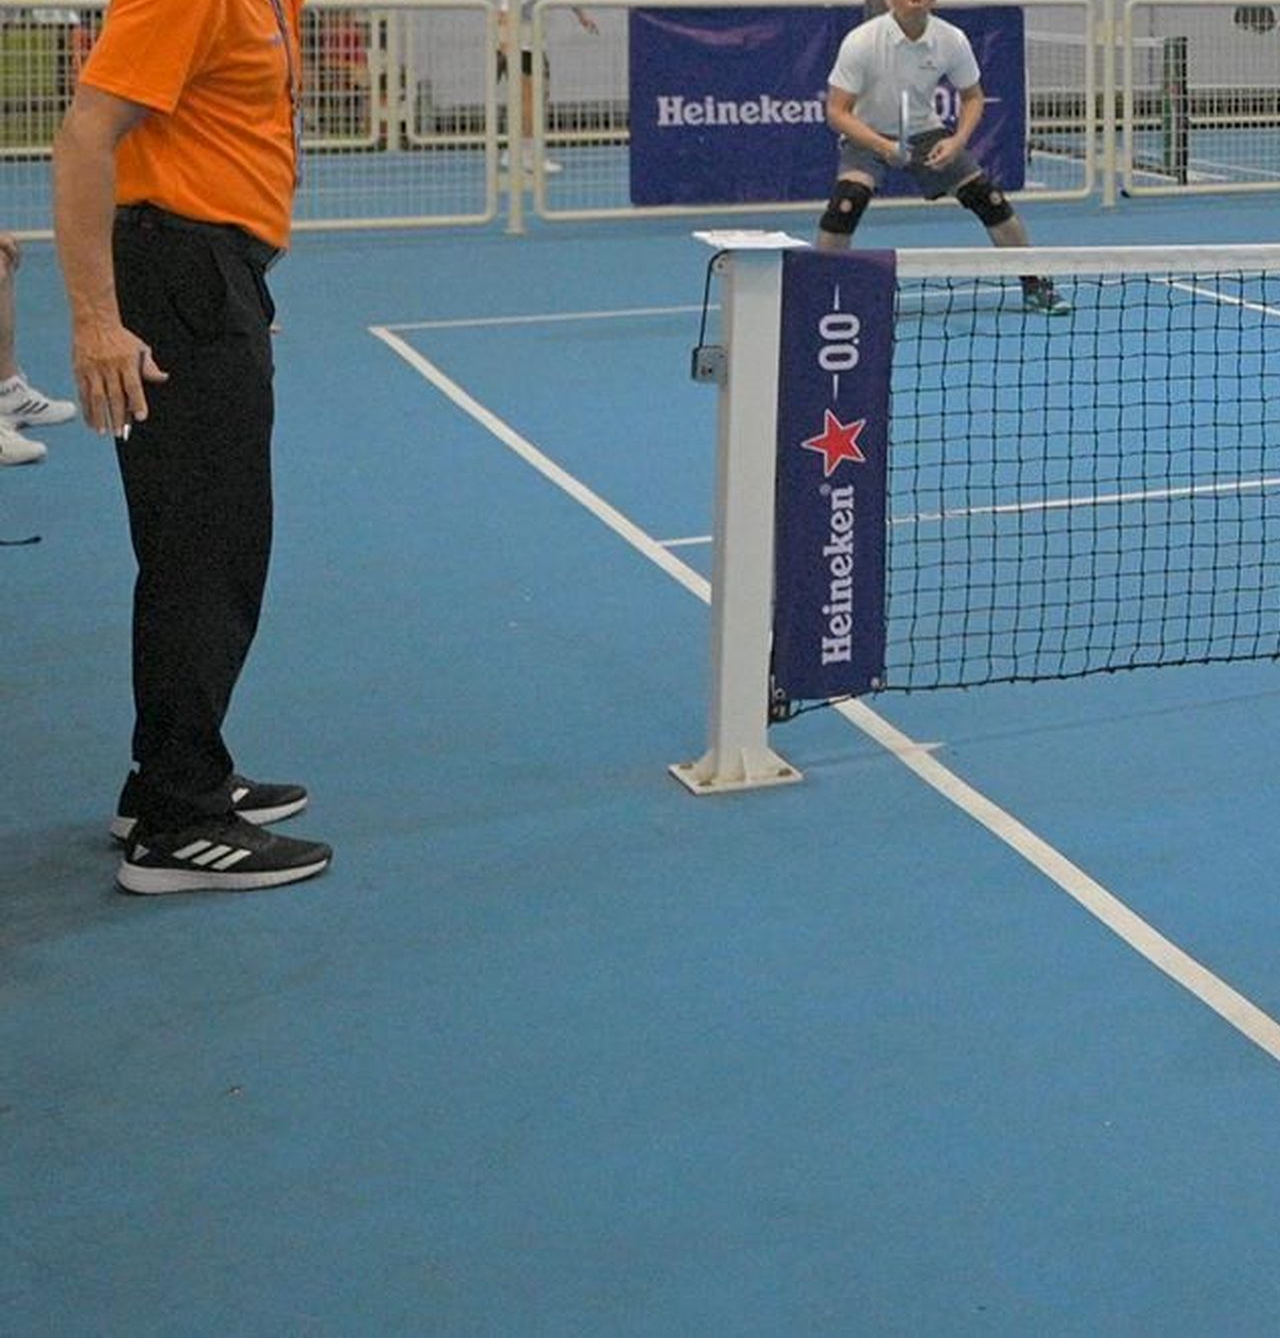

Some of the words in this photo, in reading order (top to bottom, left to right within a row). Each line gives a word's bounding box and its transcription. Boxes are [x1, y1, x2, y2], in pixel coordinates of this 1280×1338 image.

[657, 93, 826, 128] Heineken
[818, 312, 861, 373] 0.0
[821, 485, 855, 666] Heineken
